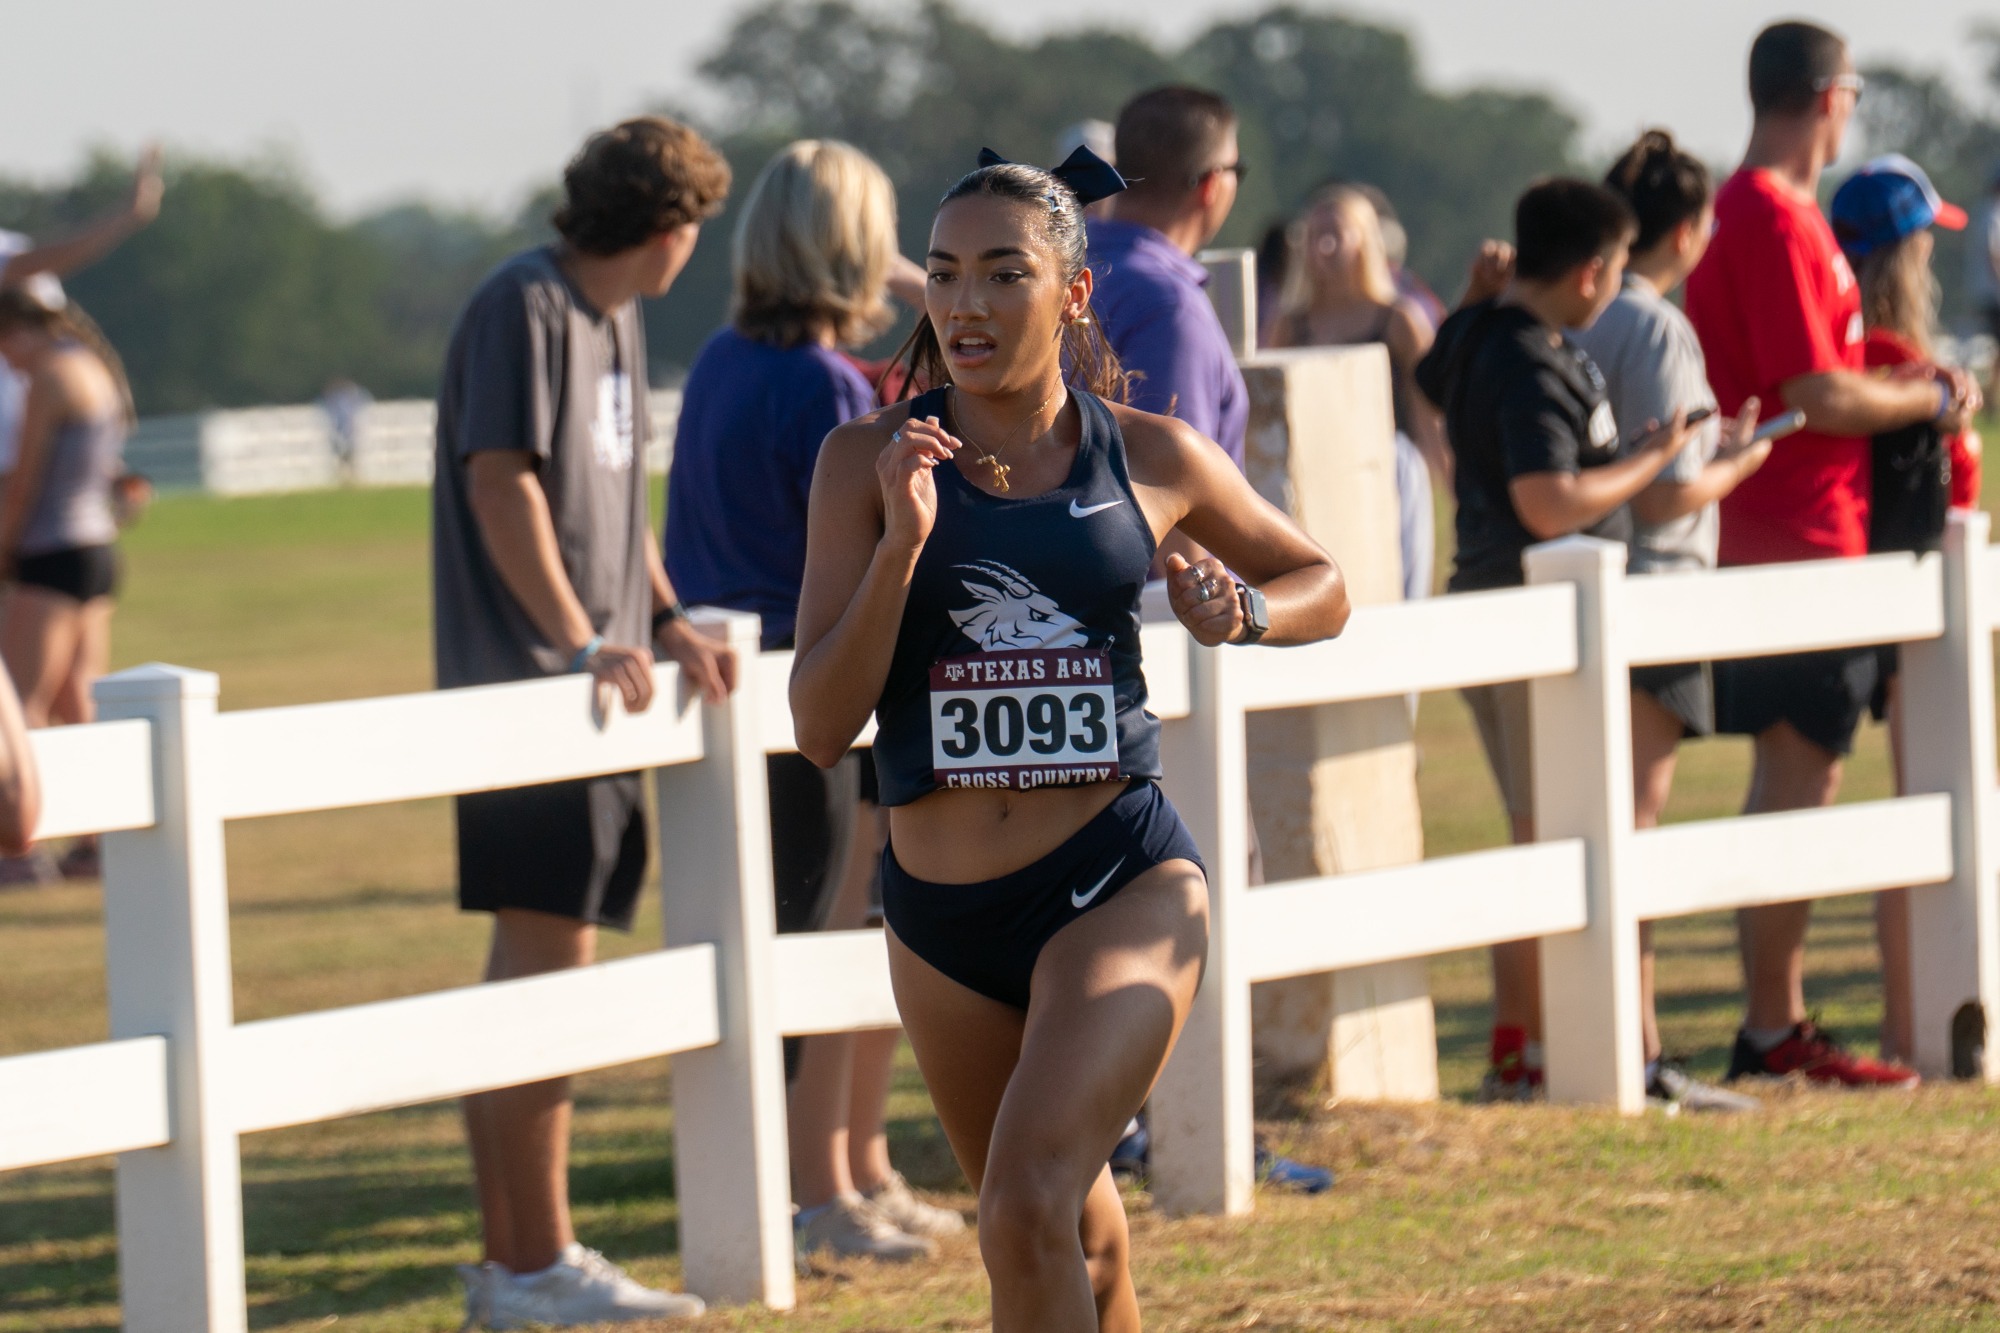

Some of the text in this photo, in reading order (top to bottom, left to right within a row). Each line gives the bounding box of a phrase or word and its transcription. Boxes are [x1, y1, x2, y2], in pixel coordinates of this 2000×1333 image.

[968, 659, 1045, 682] TEXAS
[1057, 658, 1102, 679] A&M
[940, 693, 1108, 759] 3093
[947, 768, 1111, 790] CROSS COUNTRY
